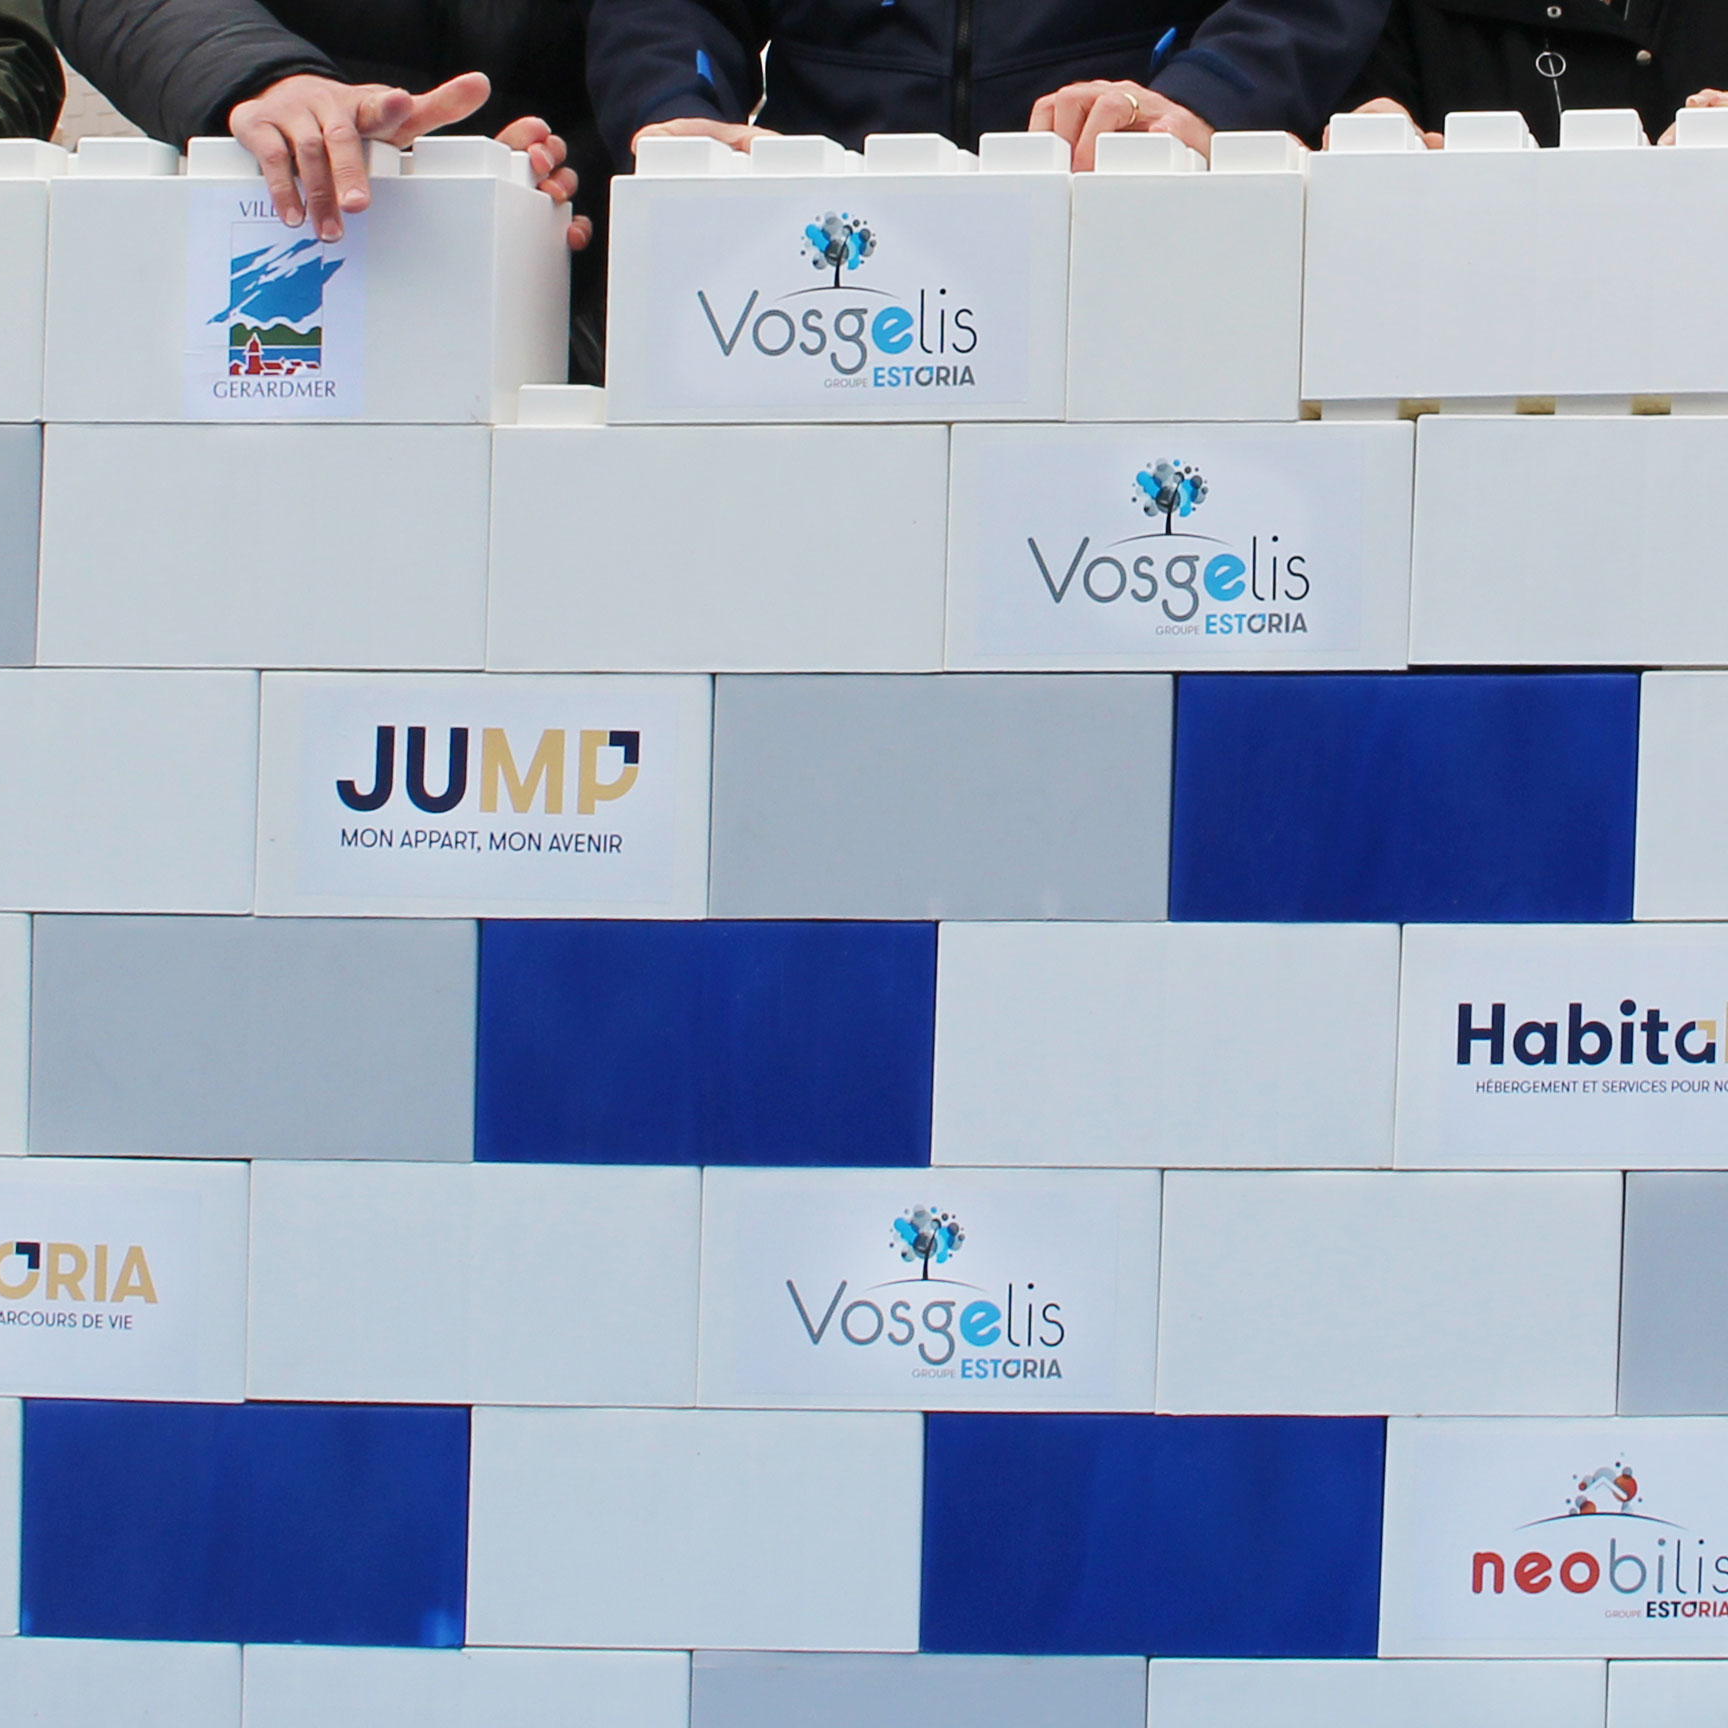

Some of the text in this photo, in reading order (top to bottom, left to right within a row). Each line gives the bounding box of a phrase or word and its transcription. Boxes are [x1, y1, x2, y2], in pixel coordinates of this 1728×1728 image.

[239, 200, 280, 217] VILL
[697, 288, 978, 375] Vosgelis
[823, 366, 975, 389] GROUPE ESTORIA
[213, 381, 336, 398] GERARDMER
[1027, 535, 1310, 622] Vosgelis
[1155, 613, 1307, 636] GROUPE ESTORIA
[336, 726, 640, 814] JUMP
[341, 828, 622, 853] MON APPART, MON AVENIR
[1476, 1079, 1578, 1094] HÉBERGEMENT
[1583, 1080, 1598, 1093] ET
[1602, 1080, 1667, 1093] SERVICES
[1671, 1080, 1710, 1093] POUR
[82, 1314, 103, 1329] DE
[109, 1315, 132, 1330] VIE
[786, 1279, 1065, 1365] Vosgelis
[911, 1359, 1062, 1379] GROUPE ESTORIA
